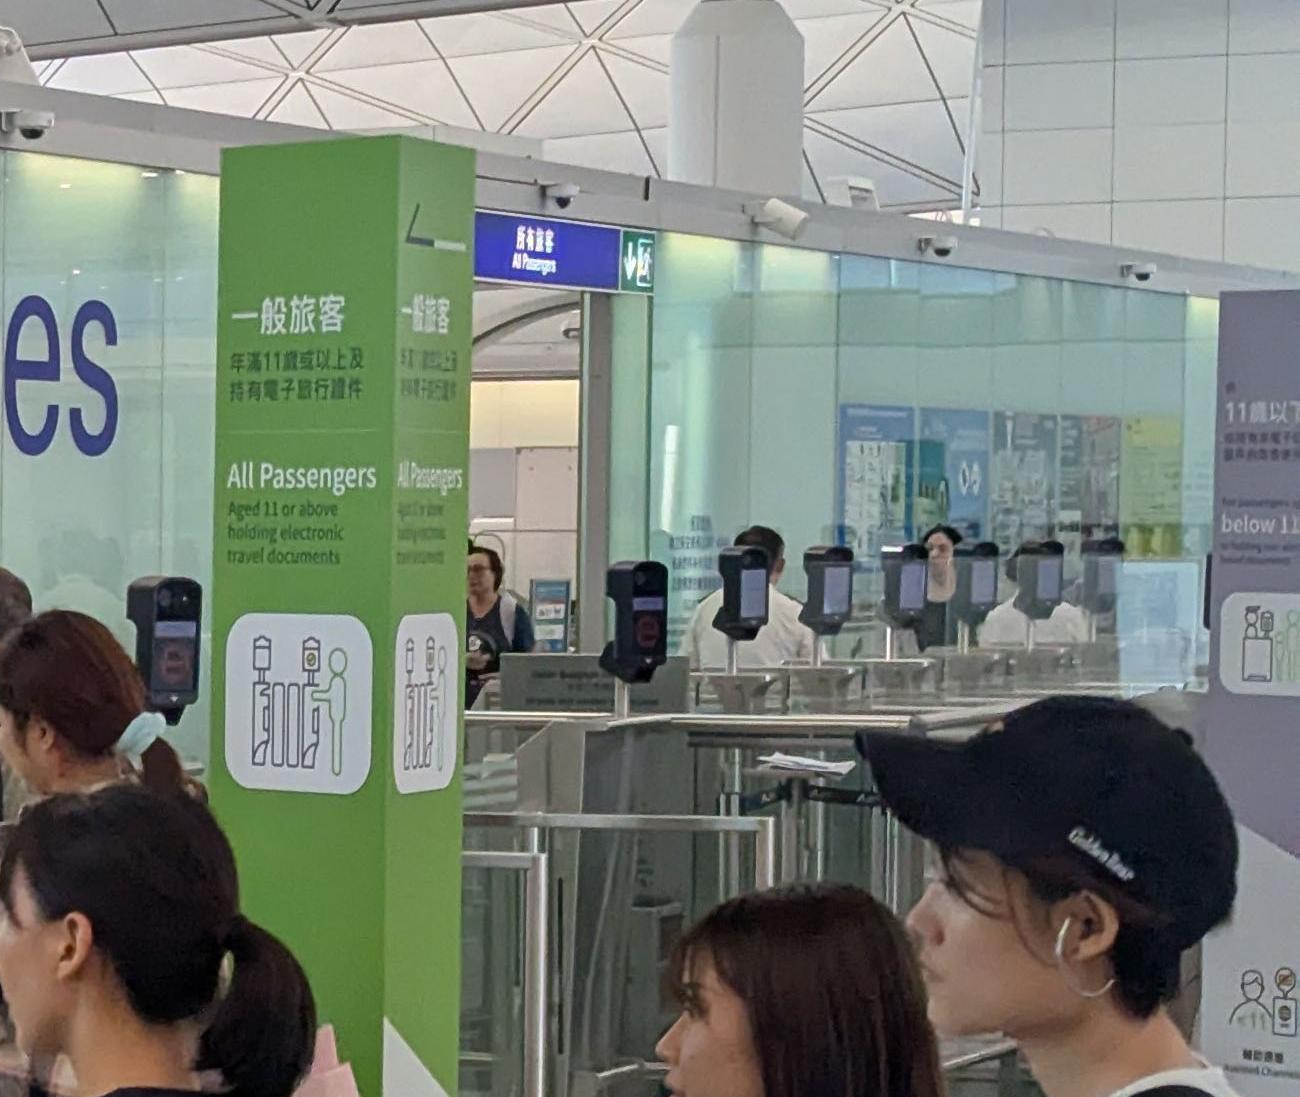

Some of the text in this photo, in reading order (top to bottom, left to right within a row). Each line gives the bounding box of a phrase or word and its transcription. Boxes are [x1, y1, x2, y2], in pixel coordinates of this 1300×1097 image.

[231, 294, 346, 335] 一般旅客
[227, 461, 377, 496] All Passengers
[228, 499, 338, 521] Aged 11 or above
[228, 523, 344, 544] holding electronic
[1221, 513, 1275, 534] below
[227, 547, 341, 565] travel documents
